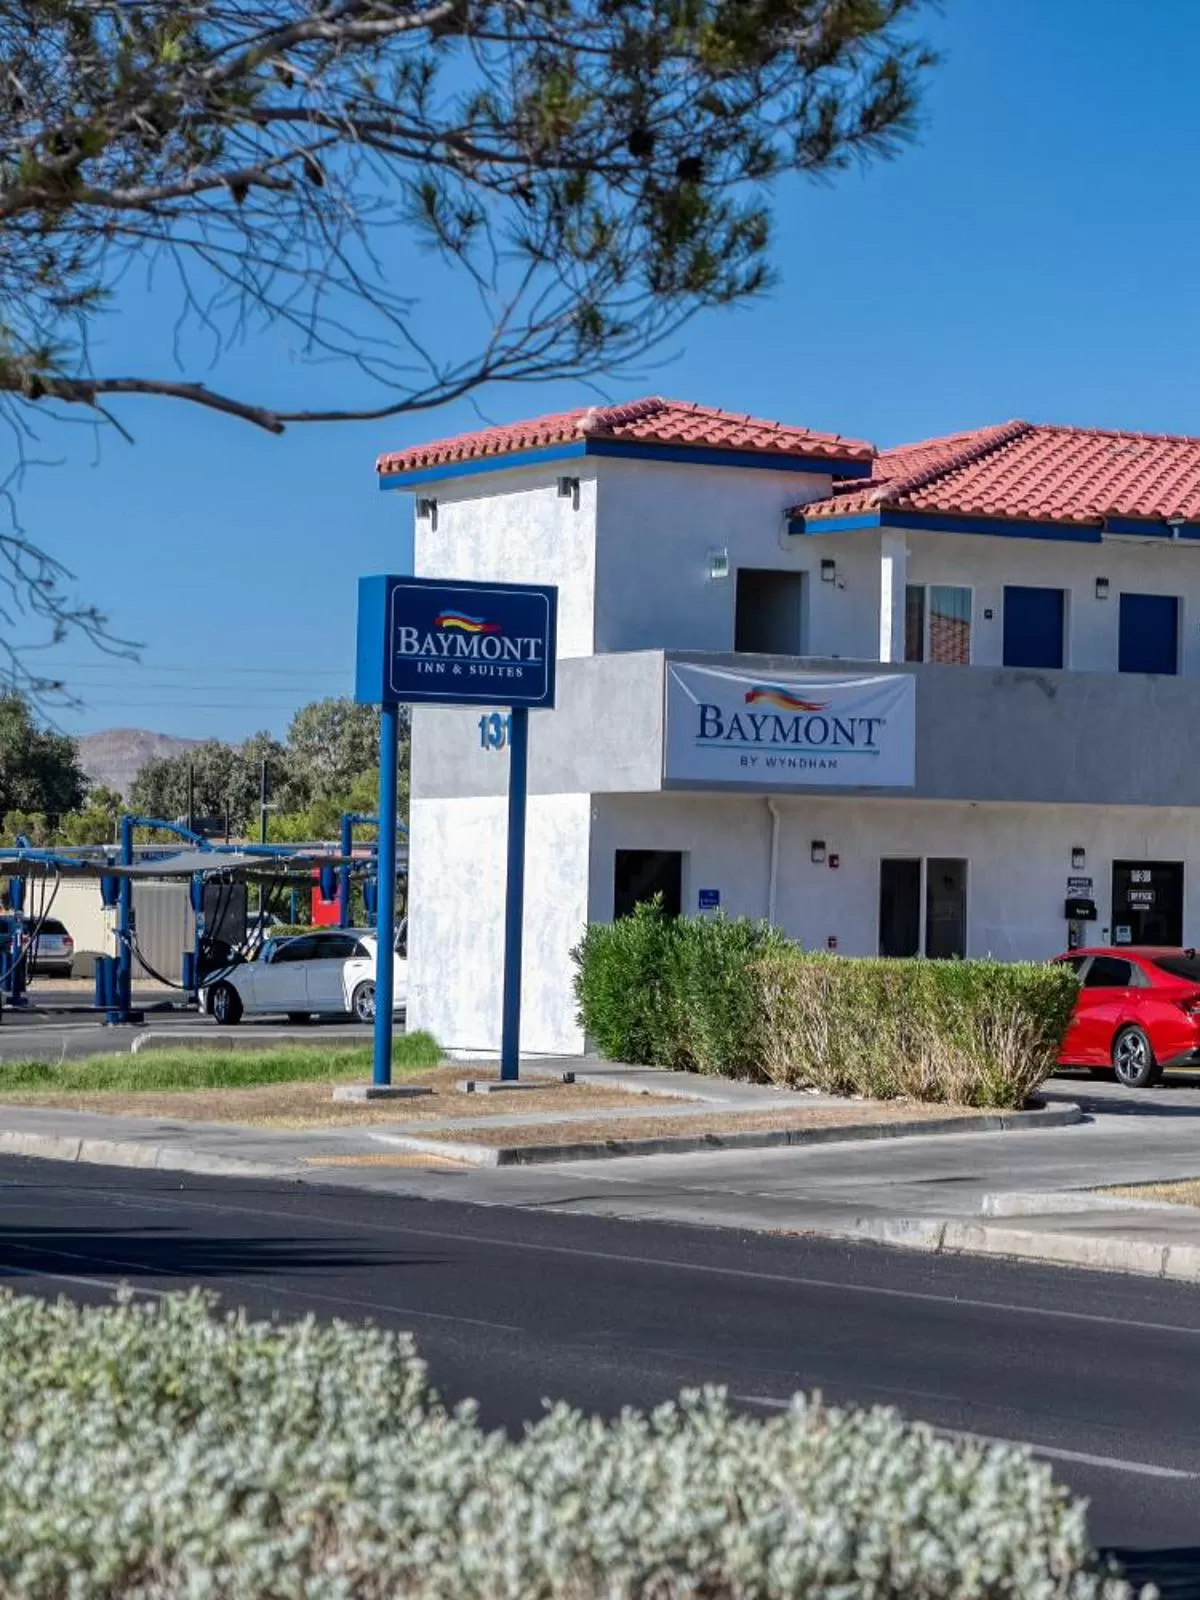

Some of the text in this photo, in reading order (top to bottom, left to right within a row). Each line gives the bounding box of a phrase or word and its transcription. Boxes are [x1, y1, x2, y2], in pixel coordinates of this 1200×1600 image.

[397, 627, 542, 661] BAYMONT
[417, 662, 523, 677] INN & SUITES
[696, 703, 881, 746] BAYMONT
[740, 755, 838, 768] BY WYNDHAM
